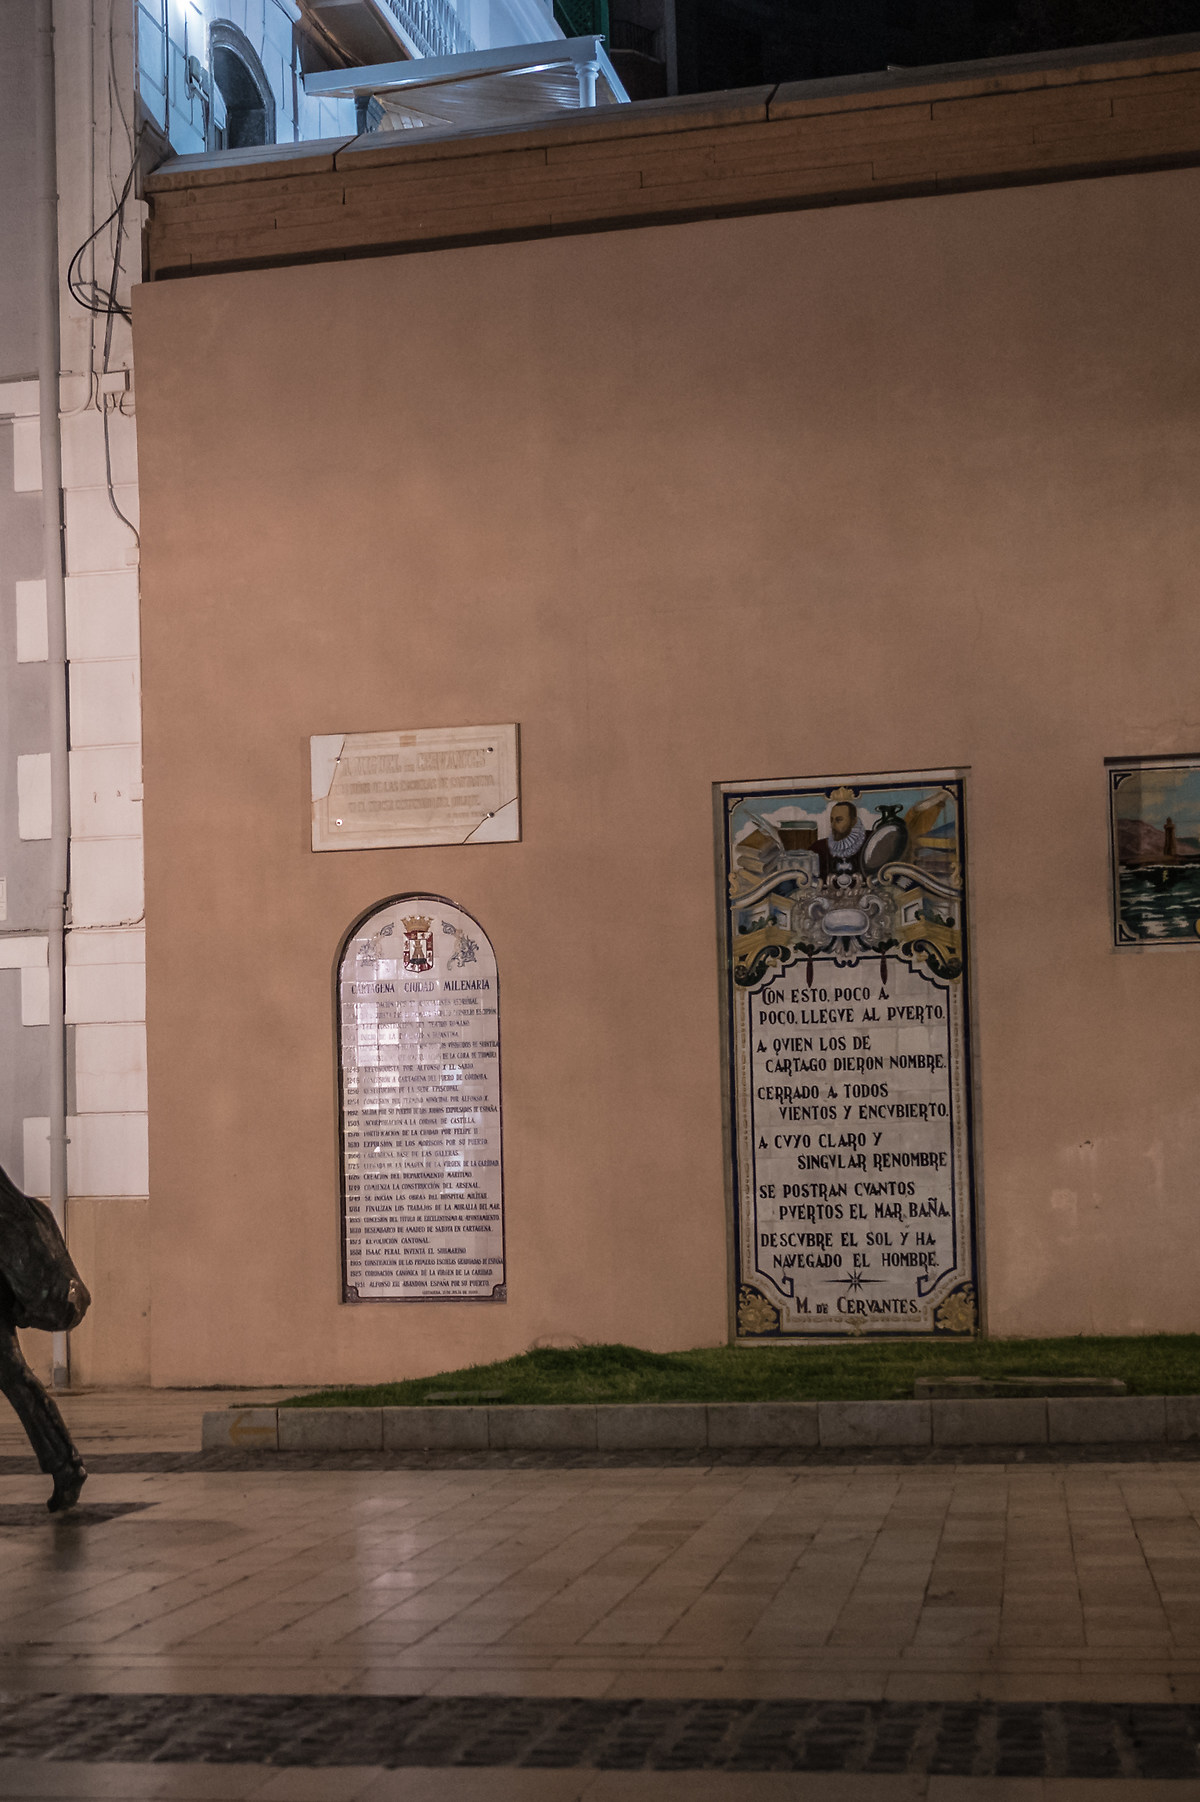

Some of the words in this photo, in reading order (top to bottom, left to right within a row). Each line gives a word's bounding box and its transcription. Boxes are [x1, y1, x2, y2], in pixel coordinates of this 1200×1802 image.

[351, 983, 395, 994] CARTAGENA
[404, 981, 434, 993] CIUDAD
[443, 979, 490, 991] MILENARIA
[762, 987, 785, 1006] CON
[791, 987, 830, 1004] ESTO.
[834, 987, 870, 1001] POCO
[878, 986, 890, 1000] A
[759, 1010, 798, 1025] POCO.
[801, 1008, 854, 1024] LLEGVE
[862, 1007, 881, 1022] AL
[887, 1005, 946, 1025] PVERTO.
[756, 1039, 767, 1053] A
[772, 1037, 813, 1055] QVIEN
[819, 1036, 846, 1051] LOS
[853, 1035, 871, 1050] DE
[765, 1058, 826, 1076] CARTAGO
[833, 1055, 884, 1074] DIERON
[889, 1053, 947, 1073] NOMBRE.
[757, 1085, 819, 1104] CERRADO
[827, 1086, 838, 1099] A
[843, 1083, 889, 1099] TODOS
[779, 1105, 837, 1121] VIENTOS
[843, 1105, 852, 1120] Y
[858, 1102, 949, 1122] ENCVBIERTO.
[758, 1135, 768, 1149] A
[774, 1134, 811, 1149] CVYO
[818, 1133, 867, 1151] CLARO
[872, 1132, 883, 1147] Y
[797, 1153, 867, 1172] SINGVLAR
[873, 1151, 948, 1171] RENOMBRE
[759, 1184, 776, 1199] SE
[783, 1182, 847, 1201] POSTRAN
[854, 1181, 915, 1196] CVANTOS
[779, 1203, 844, 1224] PVERTOS
[849, 1203, 867, 1219] EL
[874, 1202, 904, 1223] MAR
[761, 1232, 833, 1251] DESCVBRE
[840, 1232, 858, 1247] EL
[866, 1231, 893, 1246] SOL
[900, 1231, 909, 1245] Y
[915, 1230, 936, 1246] HA
[773, 1253, 843, 1269] NAVEGADO
[853, 1253, 871, 1268] EL
[881, 1251, 940, 1273] HOMBRE.
[796, 1296, 812, 1314] M.
[836, 1296, 922, 1316] CERVANTES.
